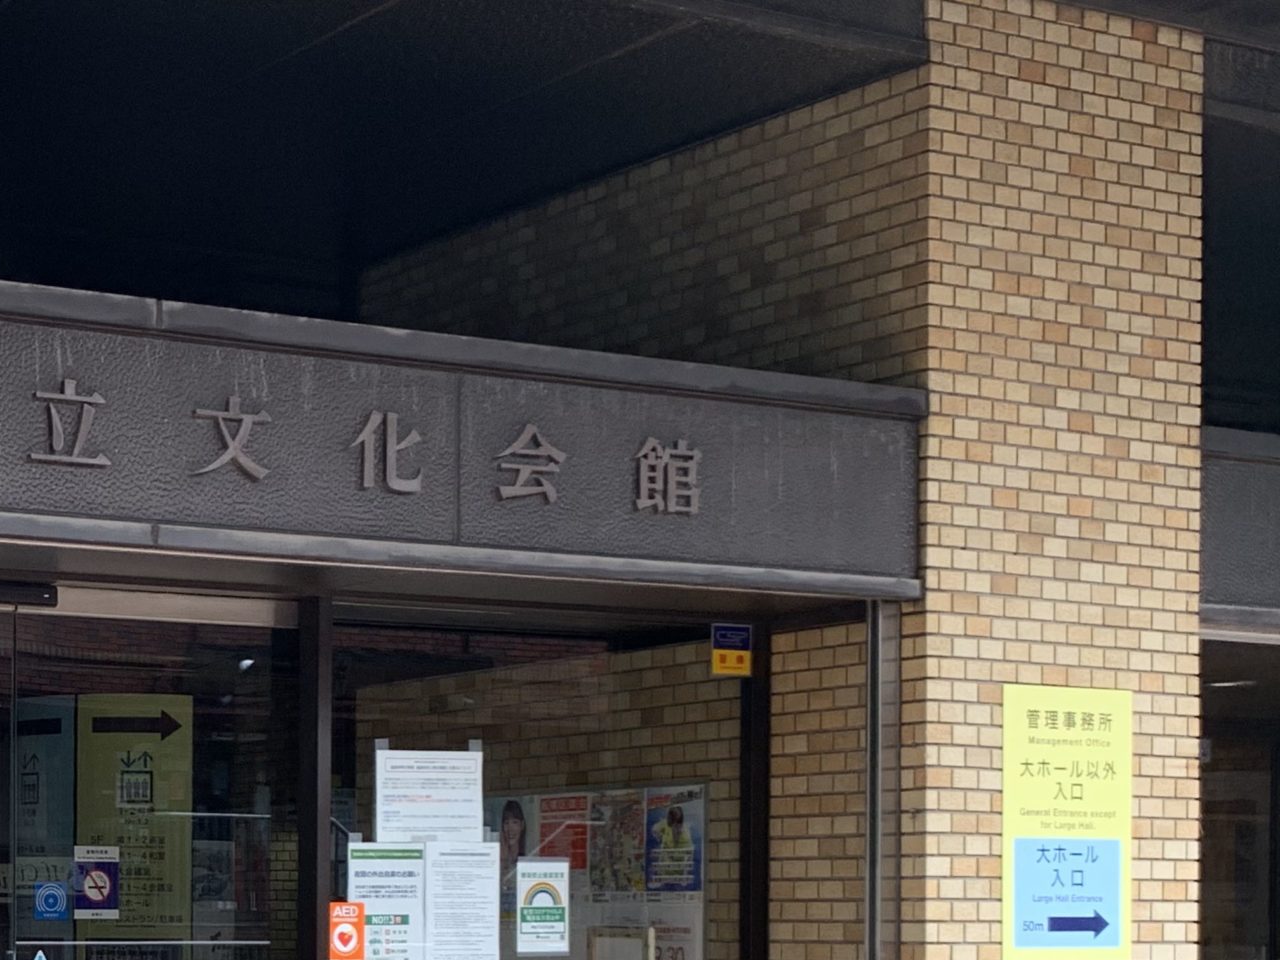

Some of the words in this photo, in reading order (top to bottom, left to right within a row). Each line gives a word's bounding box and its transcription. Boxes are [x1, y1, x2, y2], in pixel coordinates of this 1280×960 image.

[1026, 708, 1113, 733] 管理事務所
[1028, 735, 1083, 748] Management
[1085, 738, 1111, 748] Office
[1019, 758, 1117, 781] 大ホール以外
[1053, 781, 1084, 801] 入口
[1035, 844, 1100, 864] 大ホール
[1051, 868, 1084, 888] 入口
[333, 905, 359, 917] AED
[1022, 920, 1045, 932] 50m
